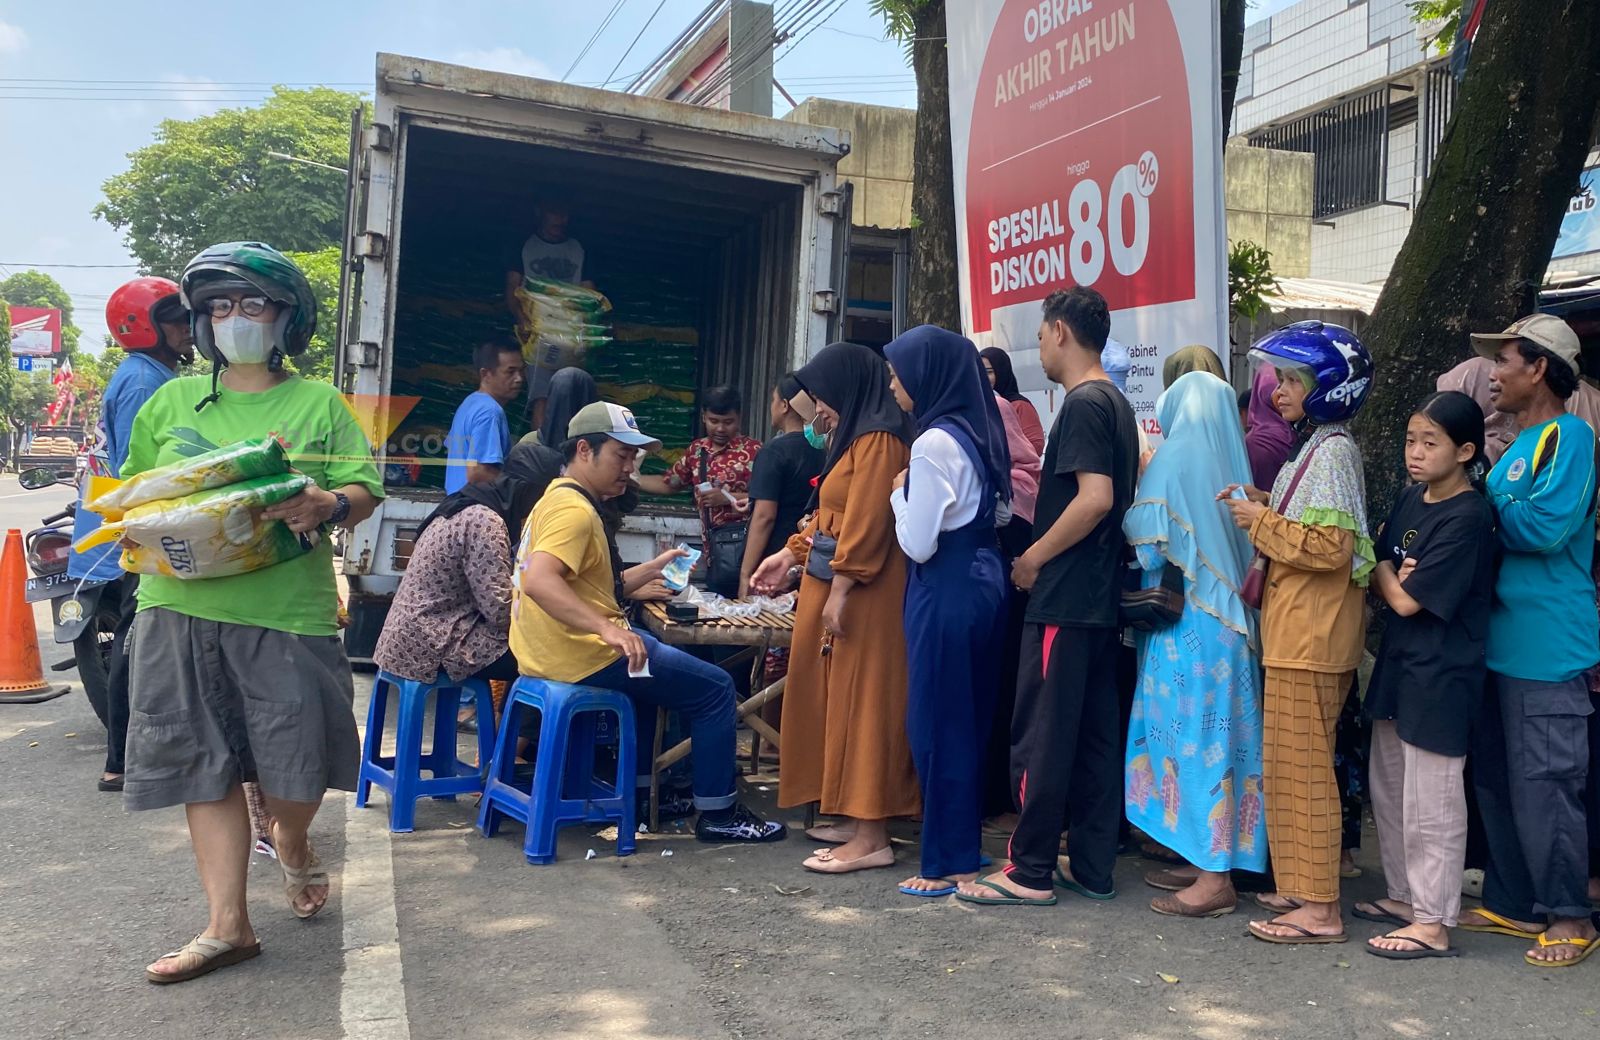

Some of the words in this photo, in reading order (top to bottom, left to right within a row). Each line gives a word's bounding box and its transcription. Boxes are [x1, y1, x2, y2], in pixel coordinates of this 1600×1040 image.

[994, 48, 1052, 107] AKHIR
[1055, 3, 1136, 75] TAHUN
[1056, 82, 1077, 100] Januari
[1077, 75, 1093, 90] 2024
[1067, 160, 1090, 176] hingga
[988, 199, 1065, 254] SPESIAL
[990, 244, 1066, 295] DISKON
[22, 359, 29, 369] P
[1131, 363, 1155, 377] Pintu
